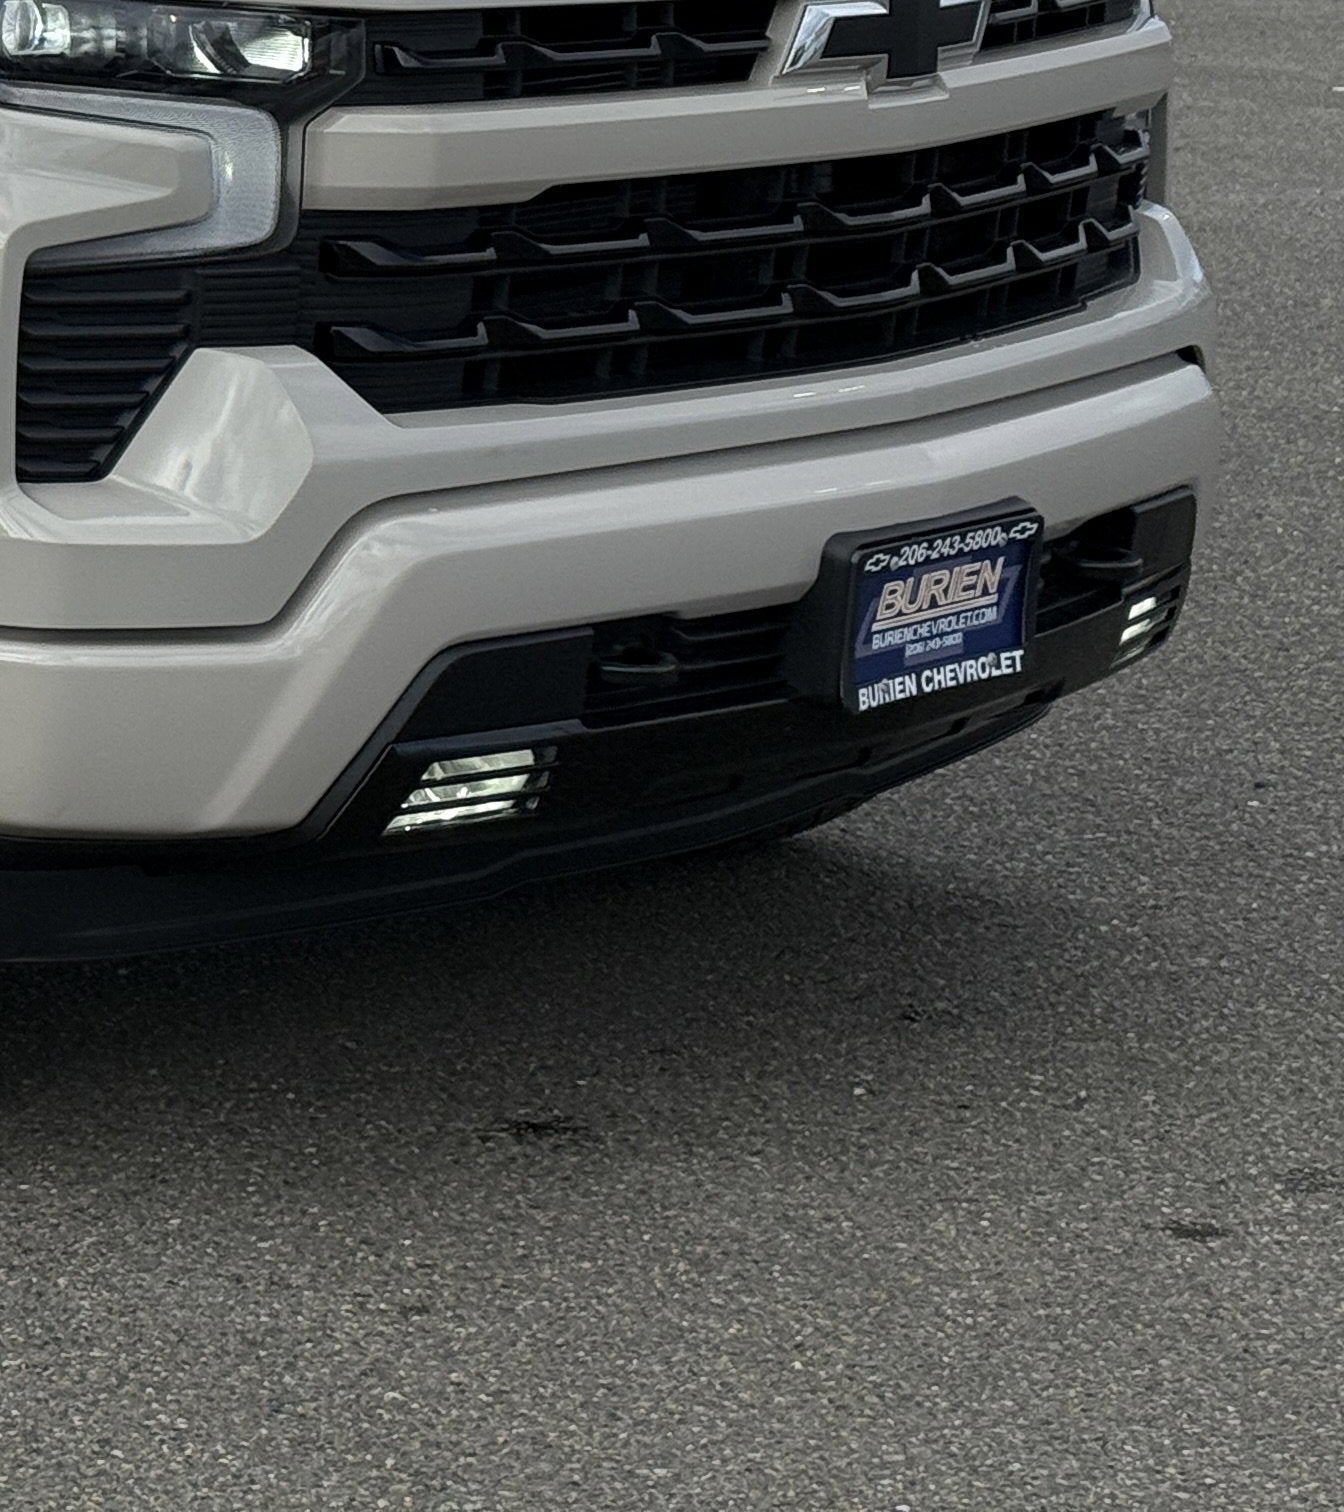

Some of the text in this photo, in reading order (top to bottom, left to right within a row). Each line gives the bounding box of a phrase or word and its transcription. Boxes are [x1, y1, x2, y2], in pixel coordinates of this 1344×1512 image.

[898, 526, 1002, 566] 206-243-5800
[876, 556, 1006, 621] BURIEN
[872, 605, 998, 650] BURIENCHEVROLET.COM
[921, 649, 1025, 693] CHEVROLET
